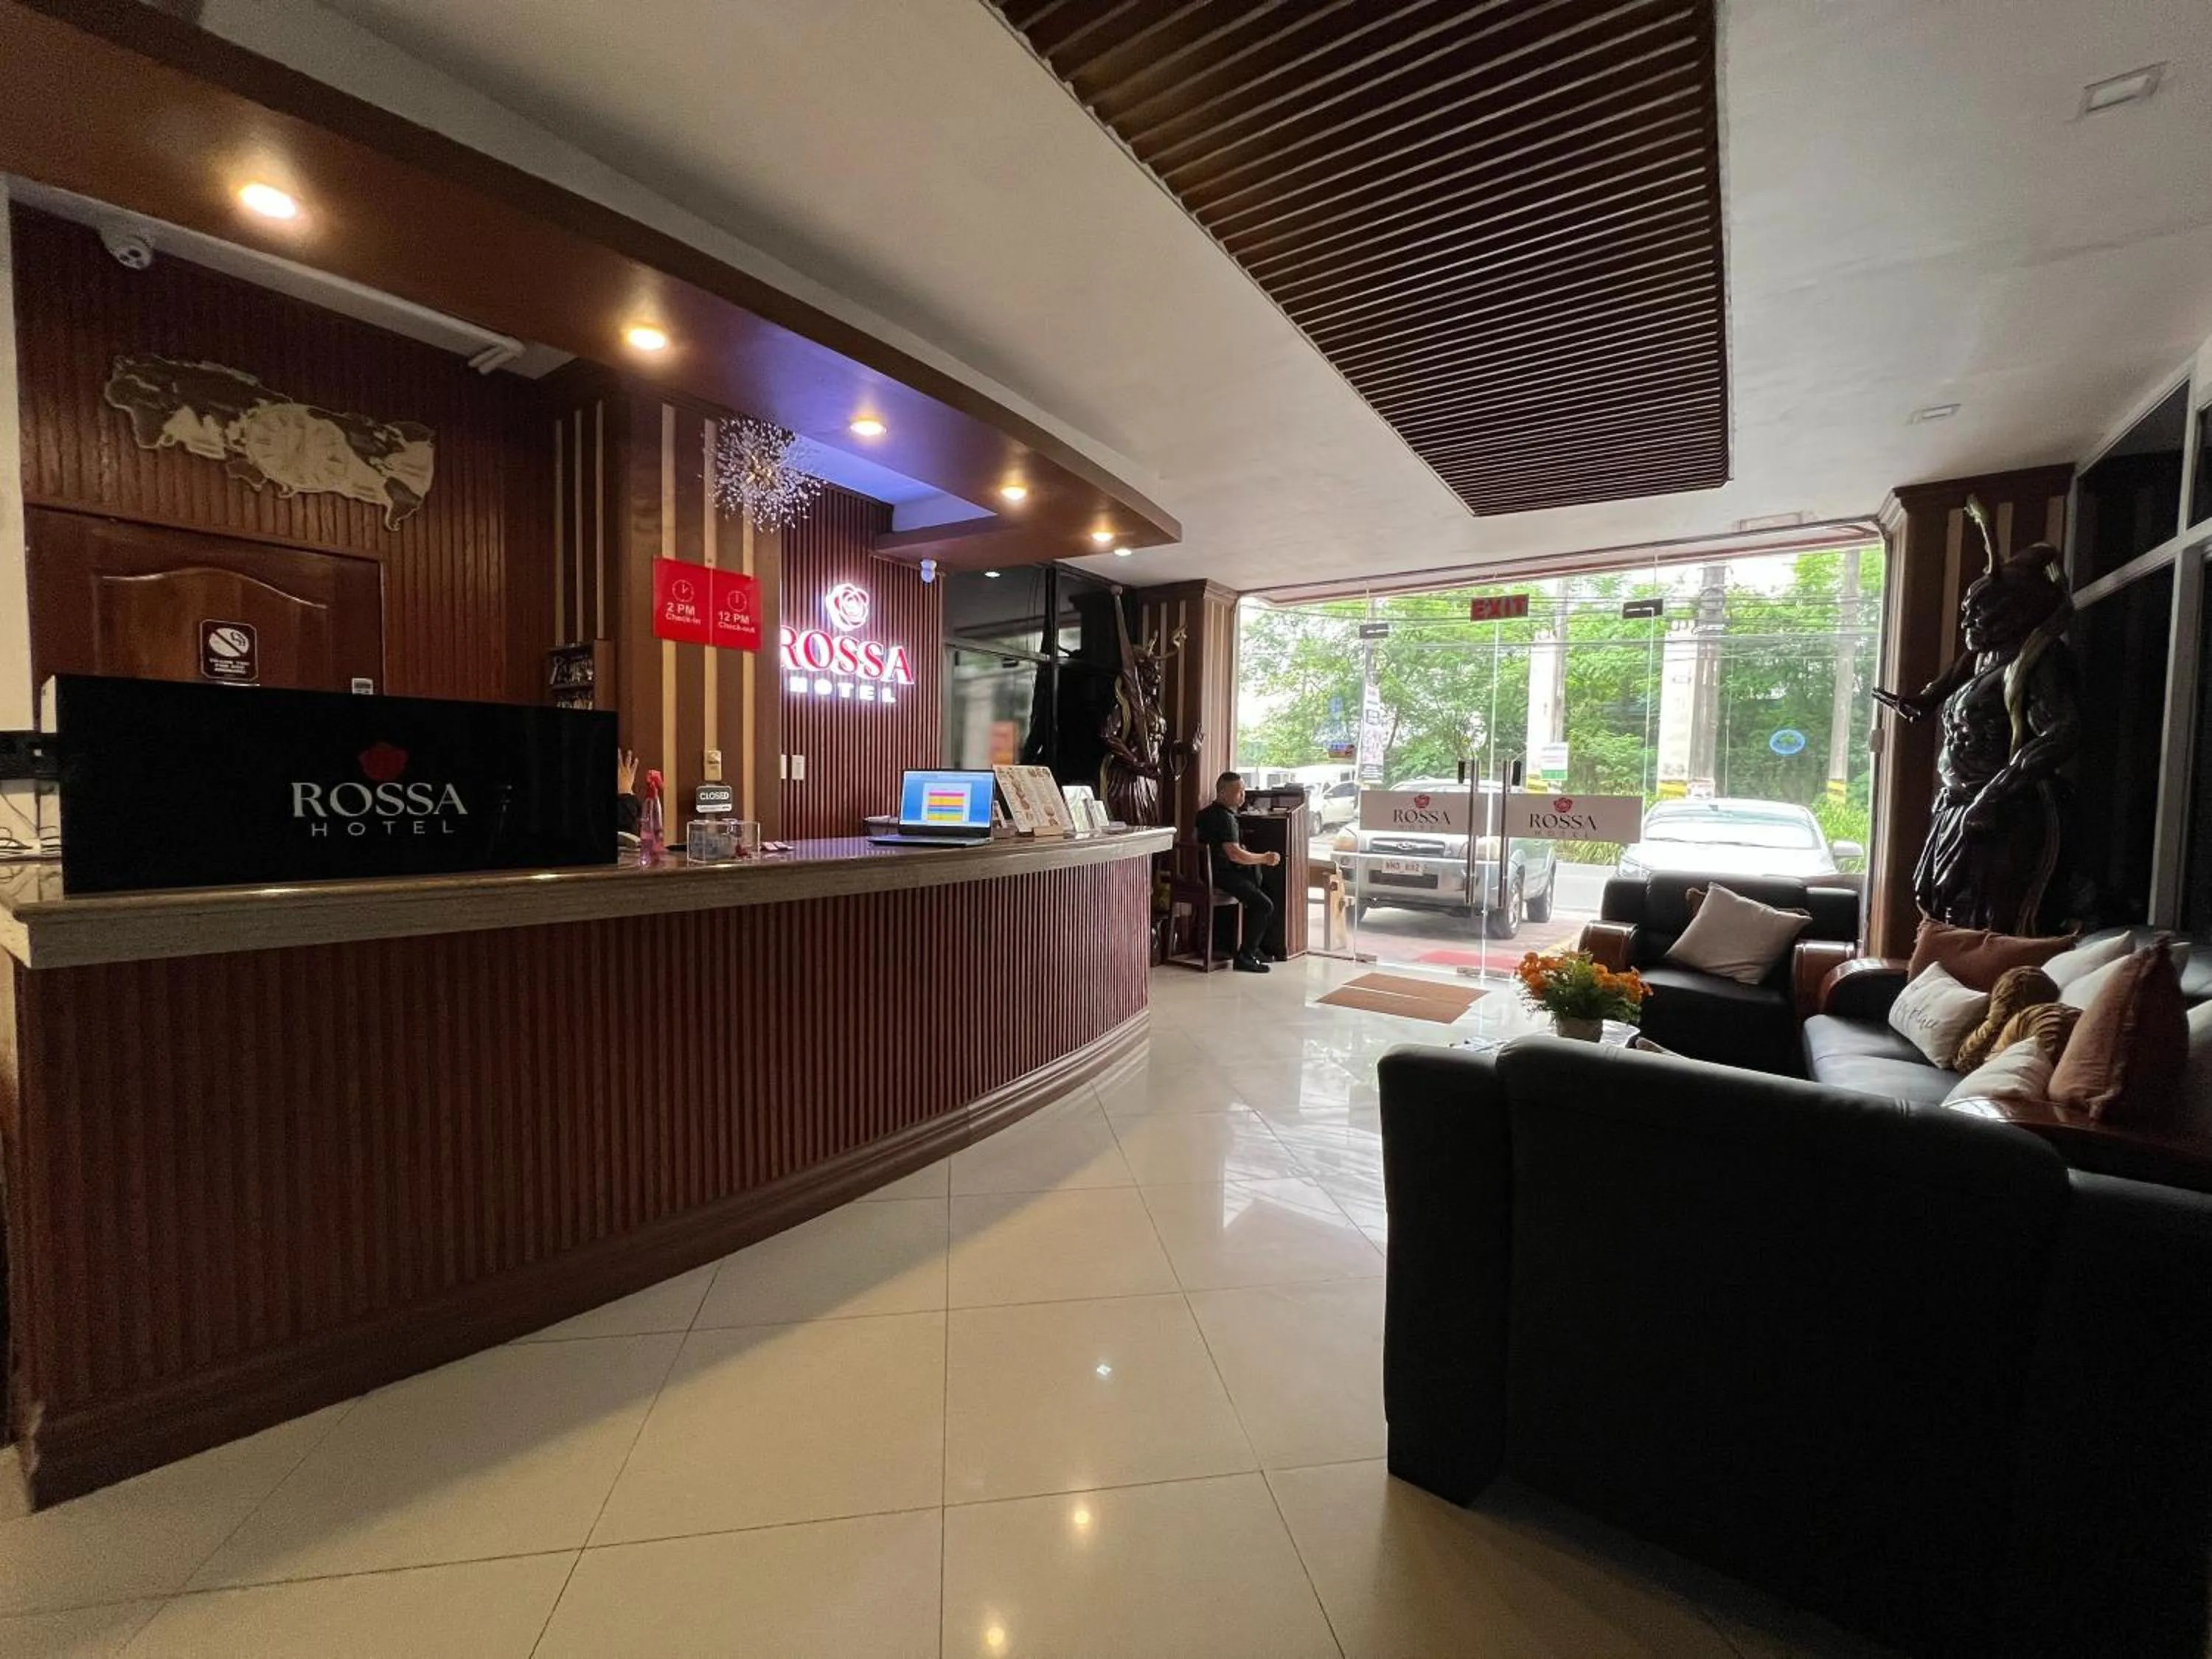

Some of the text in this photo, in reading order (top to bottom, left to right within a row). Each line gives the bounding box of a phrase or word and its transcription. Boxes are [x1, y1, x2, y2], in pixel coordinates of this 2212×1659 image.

[667, 602, 695, 615] 2 PM
[1472, 596, 1526, 619] EXIT
[718, 611, 750, 625] 12 PM
[780, 625, 914, 685] ROSSA
[790, 676, 897, 703] HOTEL
[291, 782, 468, 818] ROSSA
[700, 791, 729, 800] CLOSED
[1393, 809, 1450, 825] ROSSA
[1529, 813, 1596, 830] ROSSA
[311, 820, 454, 837] HOTEL
